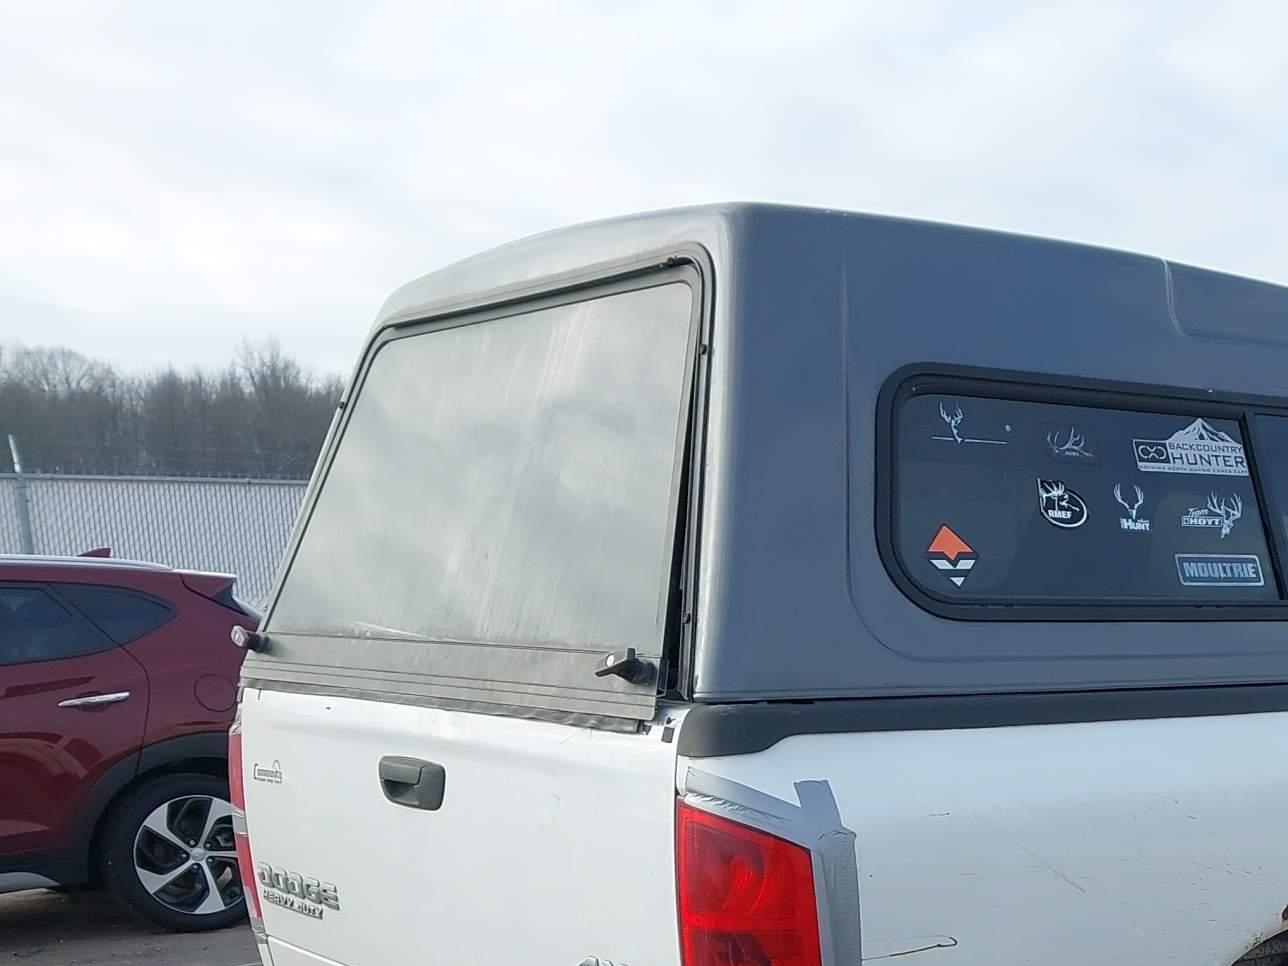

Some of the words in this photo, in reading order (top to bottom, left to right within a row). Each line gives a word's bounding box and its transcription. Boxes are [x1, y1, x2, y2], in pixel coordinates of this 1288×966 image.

[1168, 442, 1242, 454] BACKCOUNTRY
[1171, 452, 1246, 468] HUNTER
[1048, 509, 1072, 519] RMEF
[1190, 517, 1221, 526] HOYT
[1183, 562, 1257, 578] MOULTRIE
[258, 861, 340, 911] DODGE
[263, 887, 295, 908] HEAVY
[298, 901, 323, 918] DUTY
